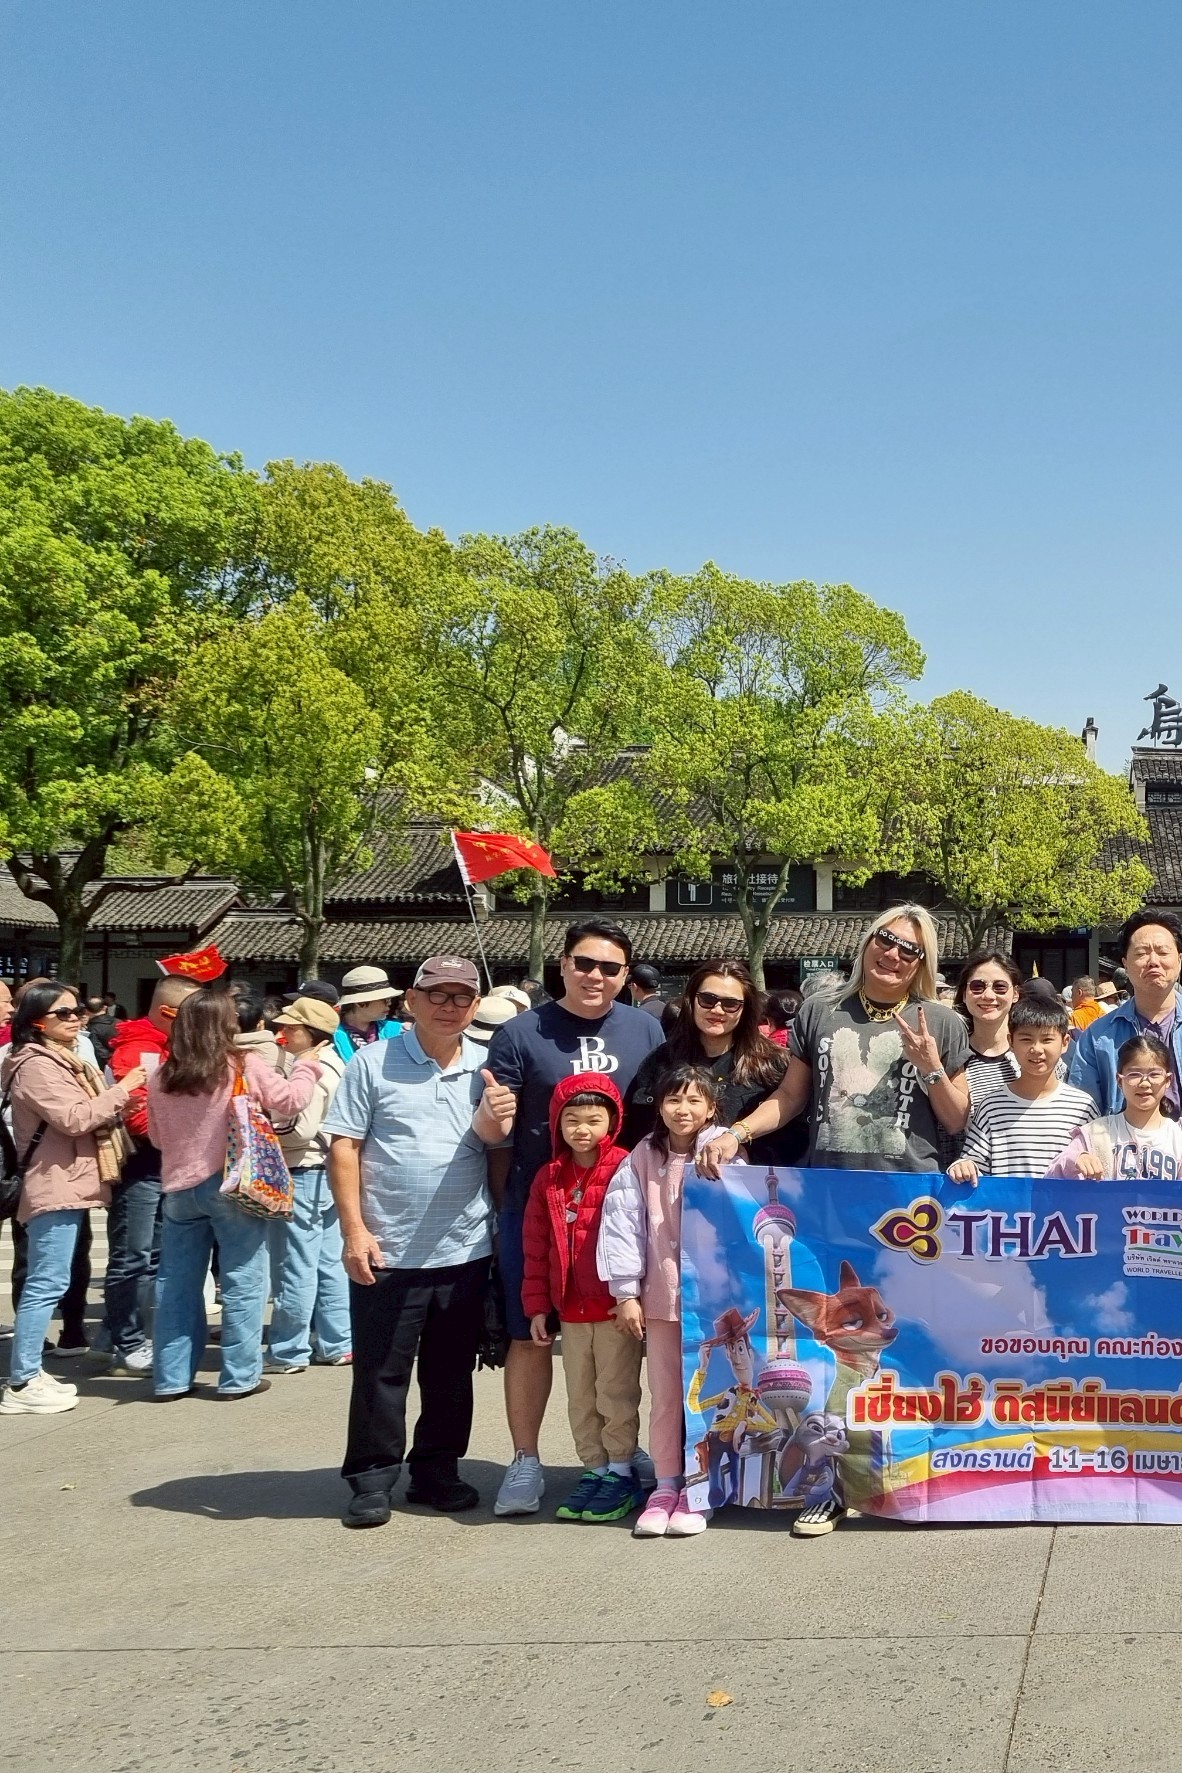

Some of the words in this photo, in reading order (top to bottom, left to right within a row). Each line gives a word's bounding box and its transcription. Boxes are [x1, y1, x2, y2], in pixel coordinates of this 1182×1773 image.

[722, 873, 789, 885] 旅社接待
[896, 1062, 919, 1129] OUTH
[947, 1212, 1096, 1257] THAI
[1126, 1266, 1150, 1274] WORLD
[980, 1337, 1088, 1360] ขอขอบคุณ
[932, 1444, 1034, 1469] สงกรานต์
